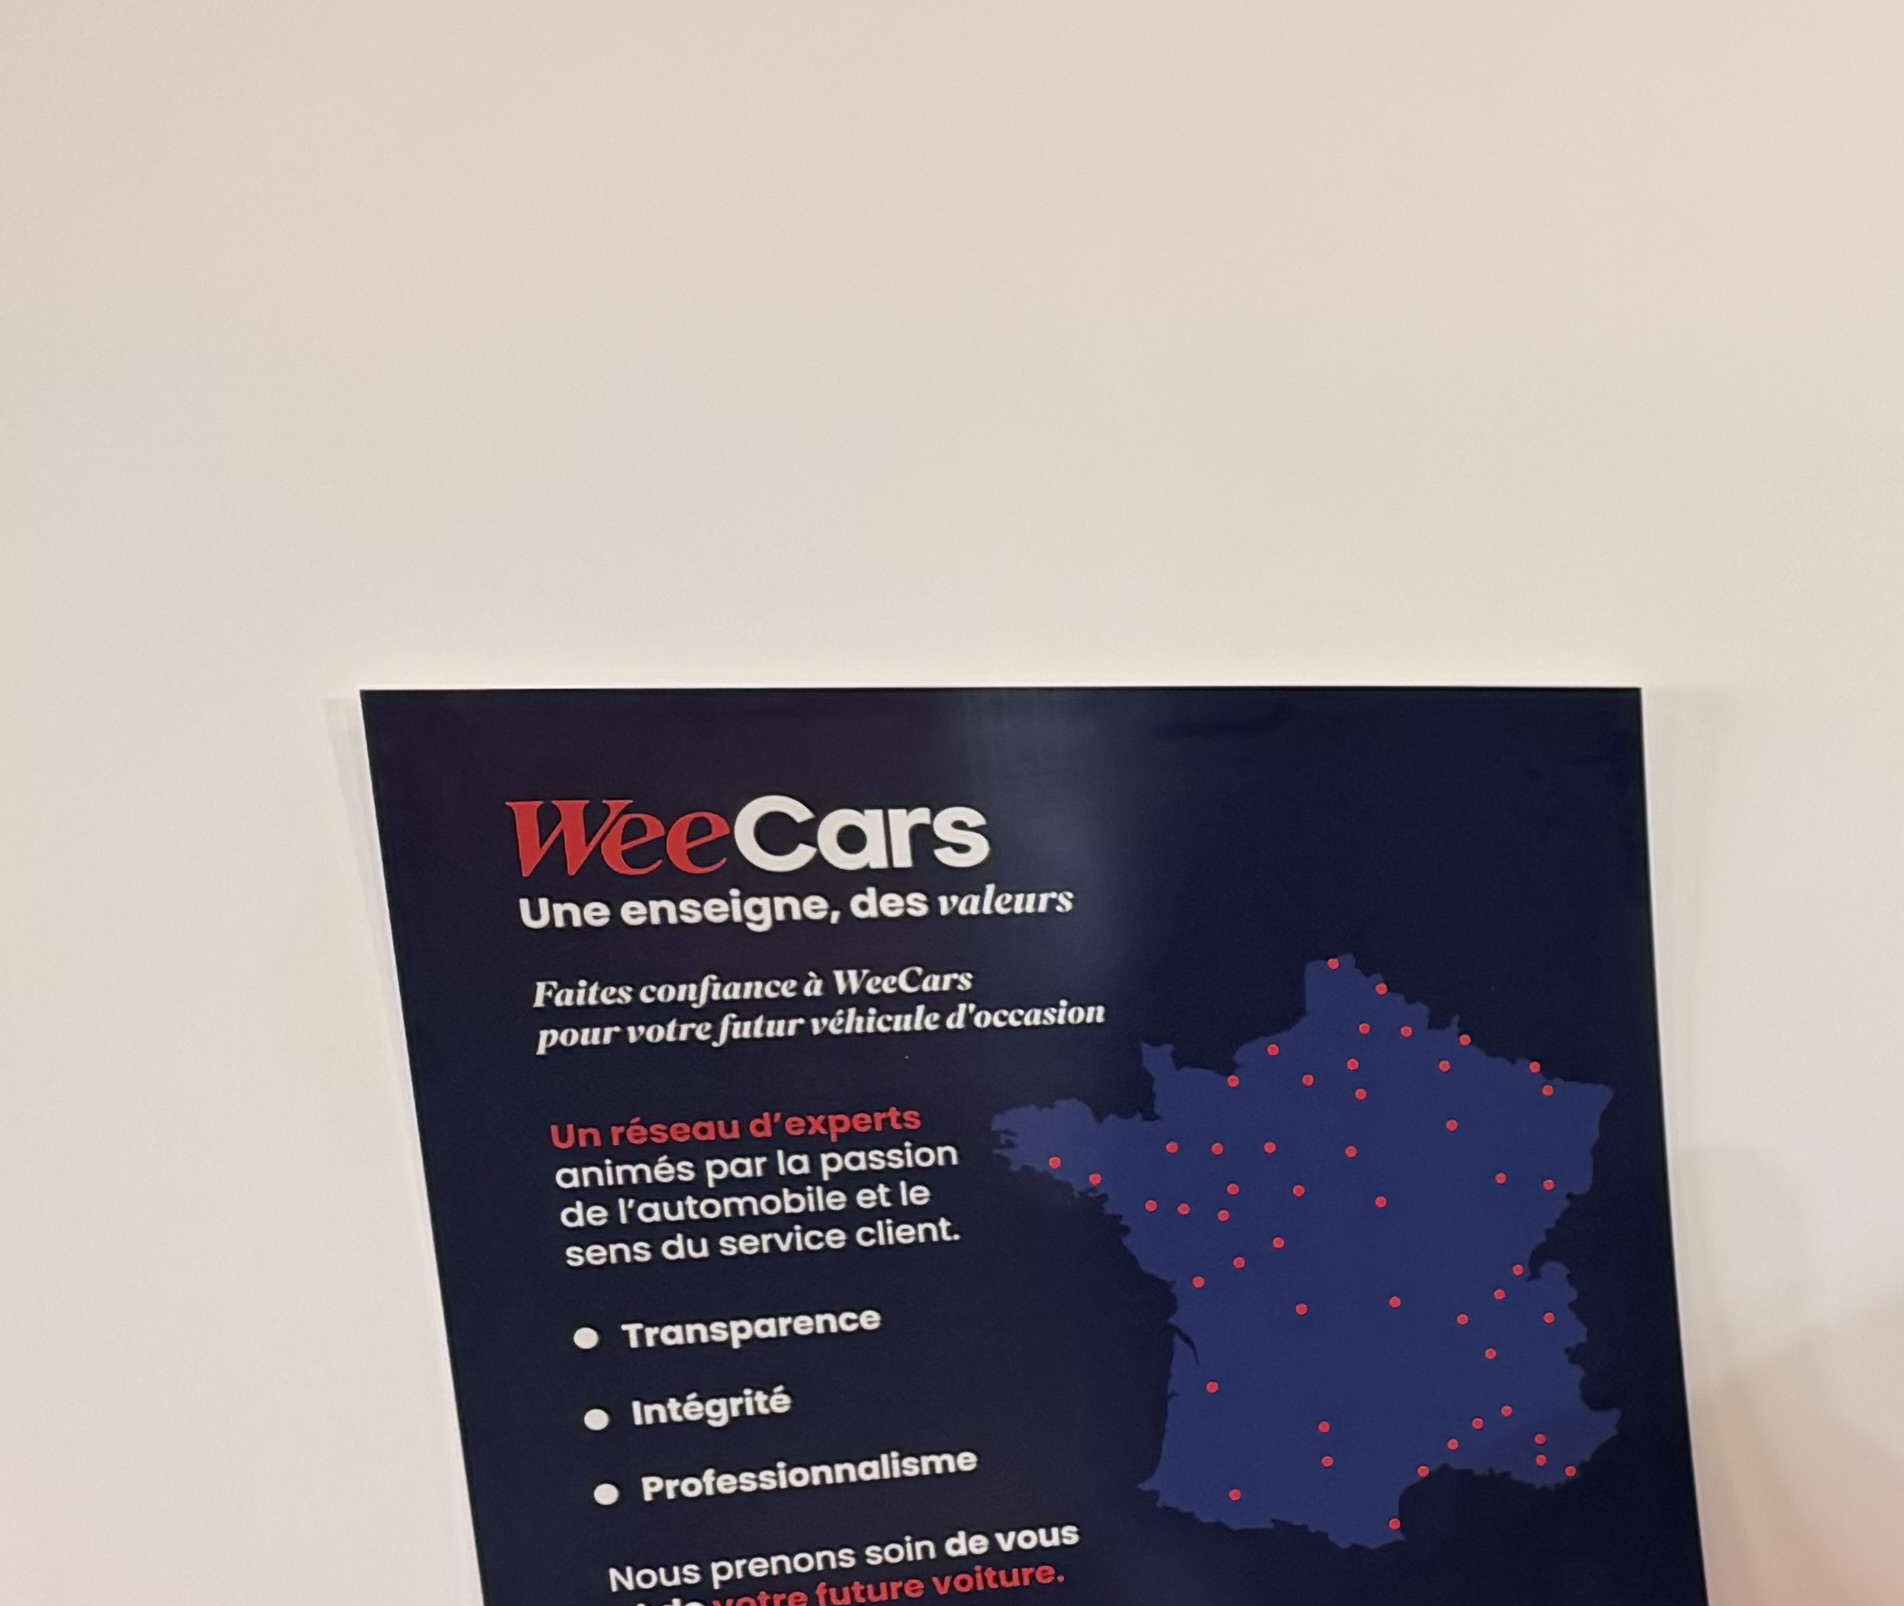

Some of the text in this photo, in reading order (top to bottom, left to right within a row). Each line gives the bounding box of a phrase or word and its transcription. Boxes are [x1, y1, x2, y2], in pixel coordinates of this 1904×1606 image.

[505, 794, 991, 878] WeeCars
[518, 882, 1075, 933] Une enseigne, des valeurs
[532, 966, 974, 1009] Faites confiance à WeeCars
[536, 998, 1106, 1056] pour votre futur véhicule d'occasion
[550, 1107, 921, 1149] Un réseau d'experts
[555, 1140, 959, 1189] animés par la passion
[560, 1180, 931, 1228] de l'automobile et le
[565, 1217, 961, 1267] sens du service client.
[620, 1309, 881, 1350] Transparence
[631, 1384, 792, 1428] Intégrité
[641, 1450, 978, 1502] Professionnalisme
[608, 1525, 1080, 1593] Nous prenons soin de vous
[932, 1565, 1065, 1598] voiture.
